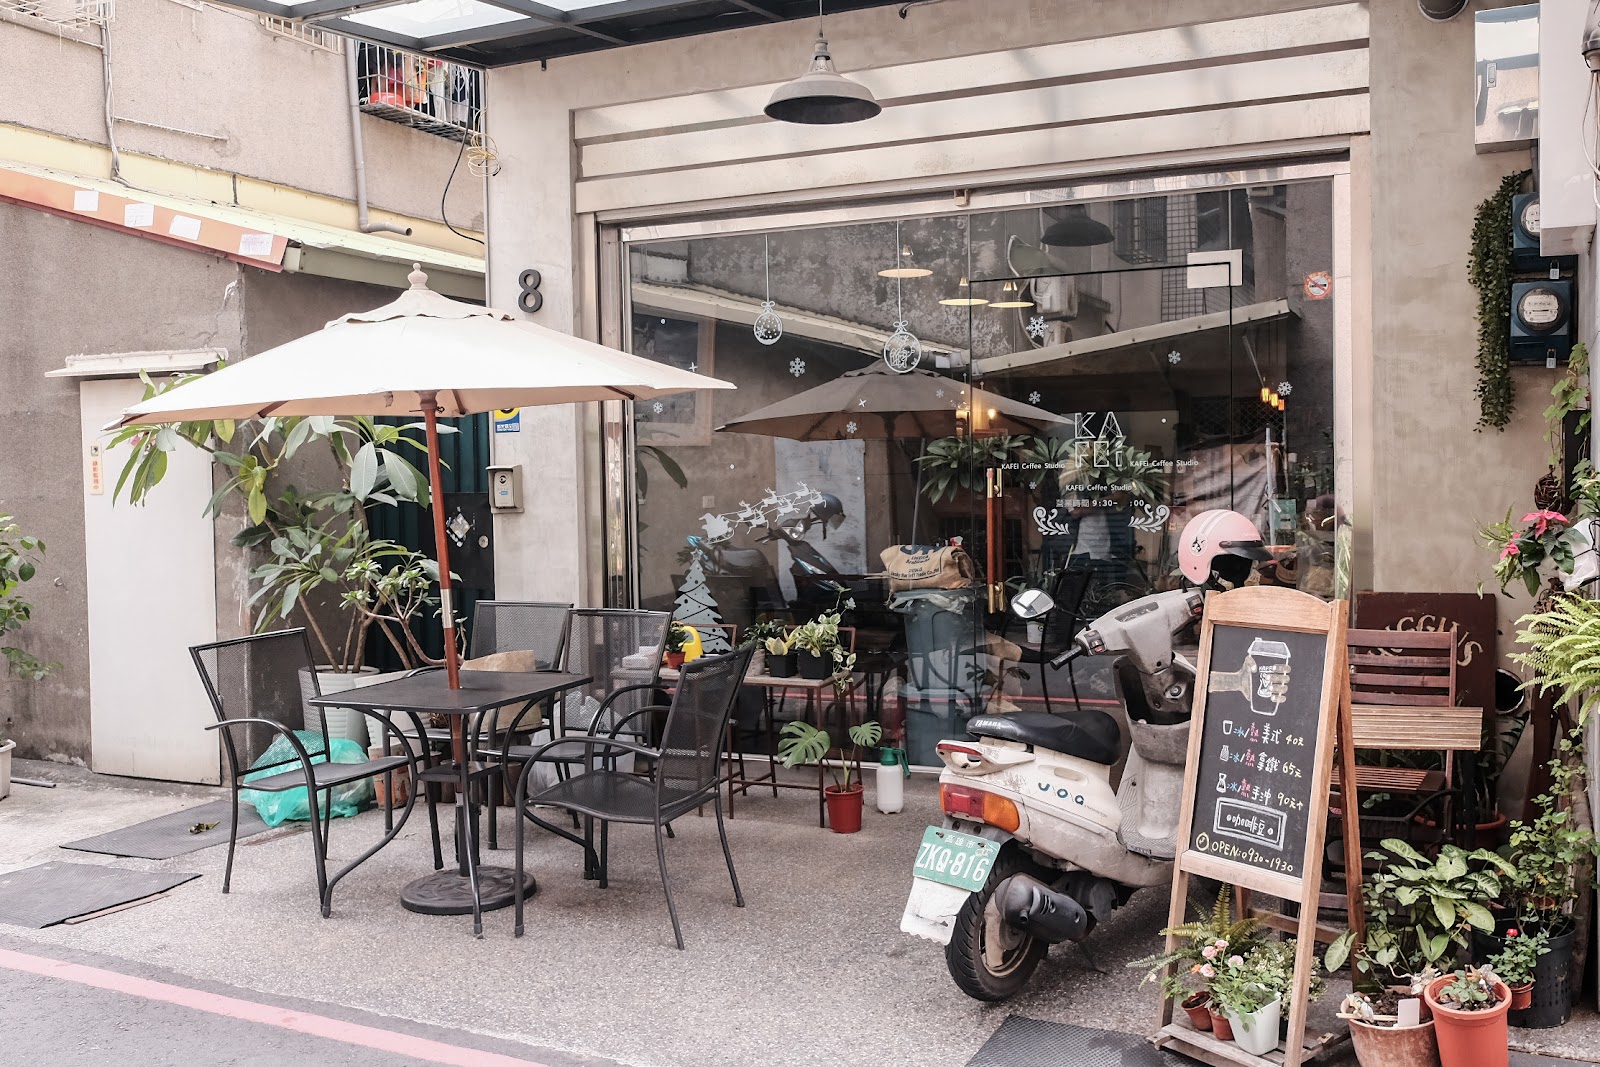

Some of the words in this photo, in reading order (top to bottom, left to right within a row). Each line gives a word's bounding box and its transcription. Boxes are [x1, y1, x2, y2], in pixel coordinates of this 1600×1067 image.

[518, 269, 543, 313] 8
[1044, 461, 1066, 469] Studio
[1110, 483, 1132, 491] Studio
[944, 834, 976, 848] 高雄市
[915, 842, 990, 882] ZKQ-816
